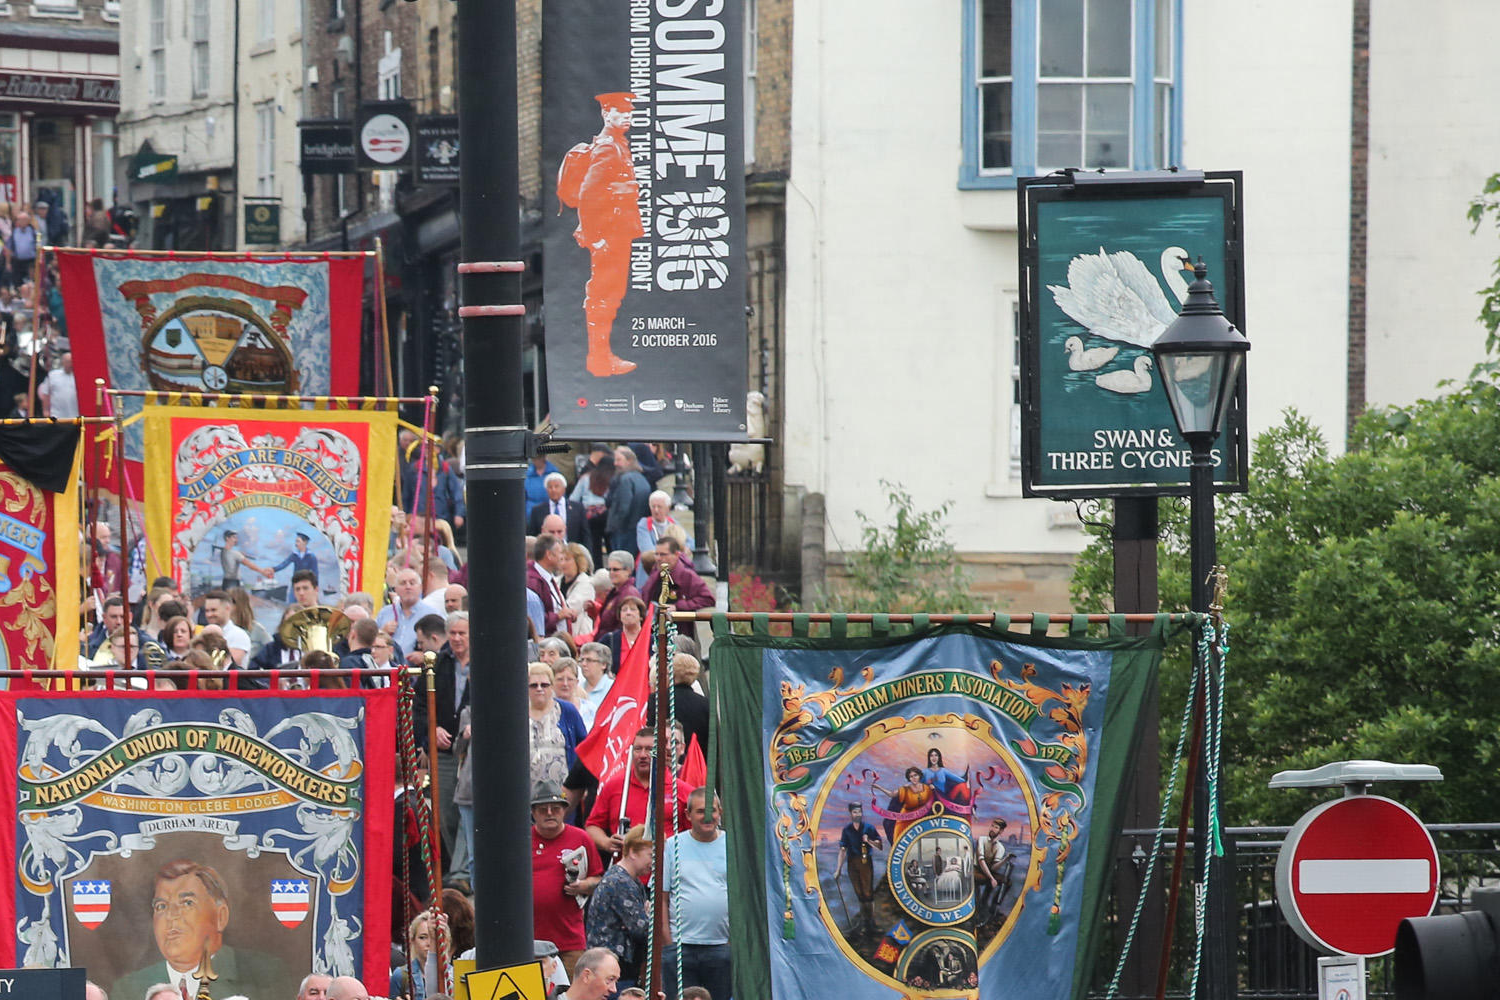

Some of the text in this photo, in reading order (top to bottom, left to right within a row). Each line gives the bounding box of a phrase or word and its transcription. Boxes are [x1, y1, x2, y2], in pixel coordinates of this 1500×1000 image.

[630, 0, 651, 32] ROM
[630, 37, 651, 103] DURHAM
[6, 75, 79, 101] Edinburgh
[630, 107, 651, 127] TO
[630, 132, 651, 161] THE
[656, 186, 730, 291] 1916
[631, 242, 652, 291] FRONT
[632, 317, 645, 330] 25
[647, 317, 685, 329] MARCH
[632, 334, 717, 347] 2 OCTOBER 2016
[1094, 428, 1176, 449] SWAN &
[1048, 449, 1222, 470] THREE CYGNES
[186, 449, 349, 504] ALL MEN ARE BRETHREN
[829, 673, 1036, 729] DURHAM MINERS ASSOCIATION
[35, 728, 347, 805] NATIONAL UNION OF MINEWORKERS
[787, 748, 818, 764] 1845
[1040, 746, 1070, 763] 1974
[102, 794, 281, 813] WASHINGTON GLEBE LODGE
[148, 818, 231, 832] DURHAM AREA
[892, 818, 950, 865] UNITED WE
[893, 880, 963, 921] DIVIDED WE
